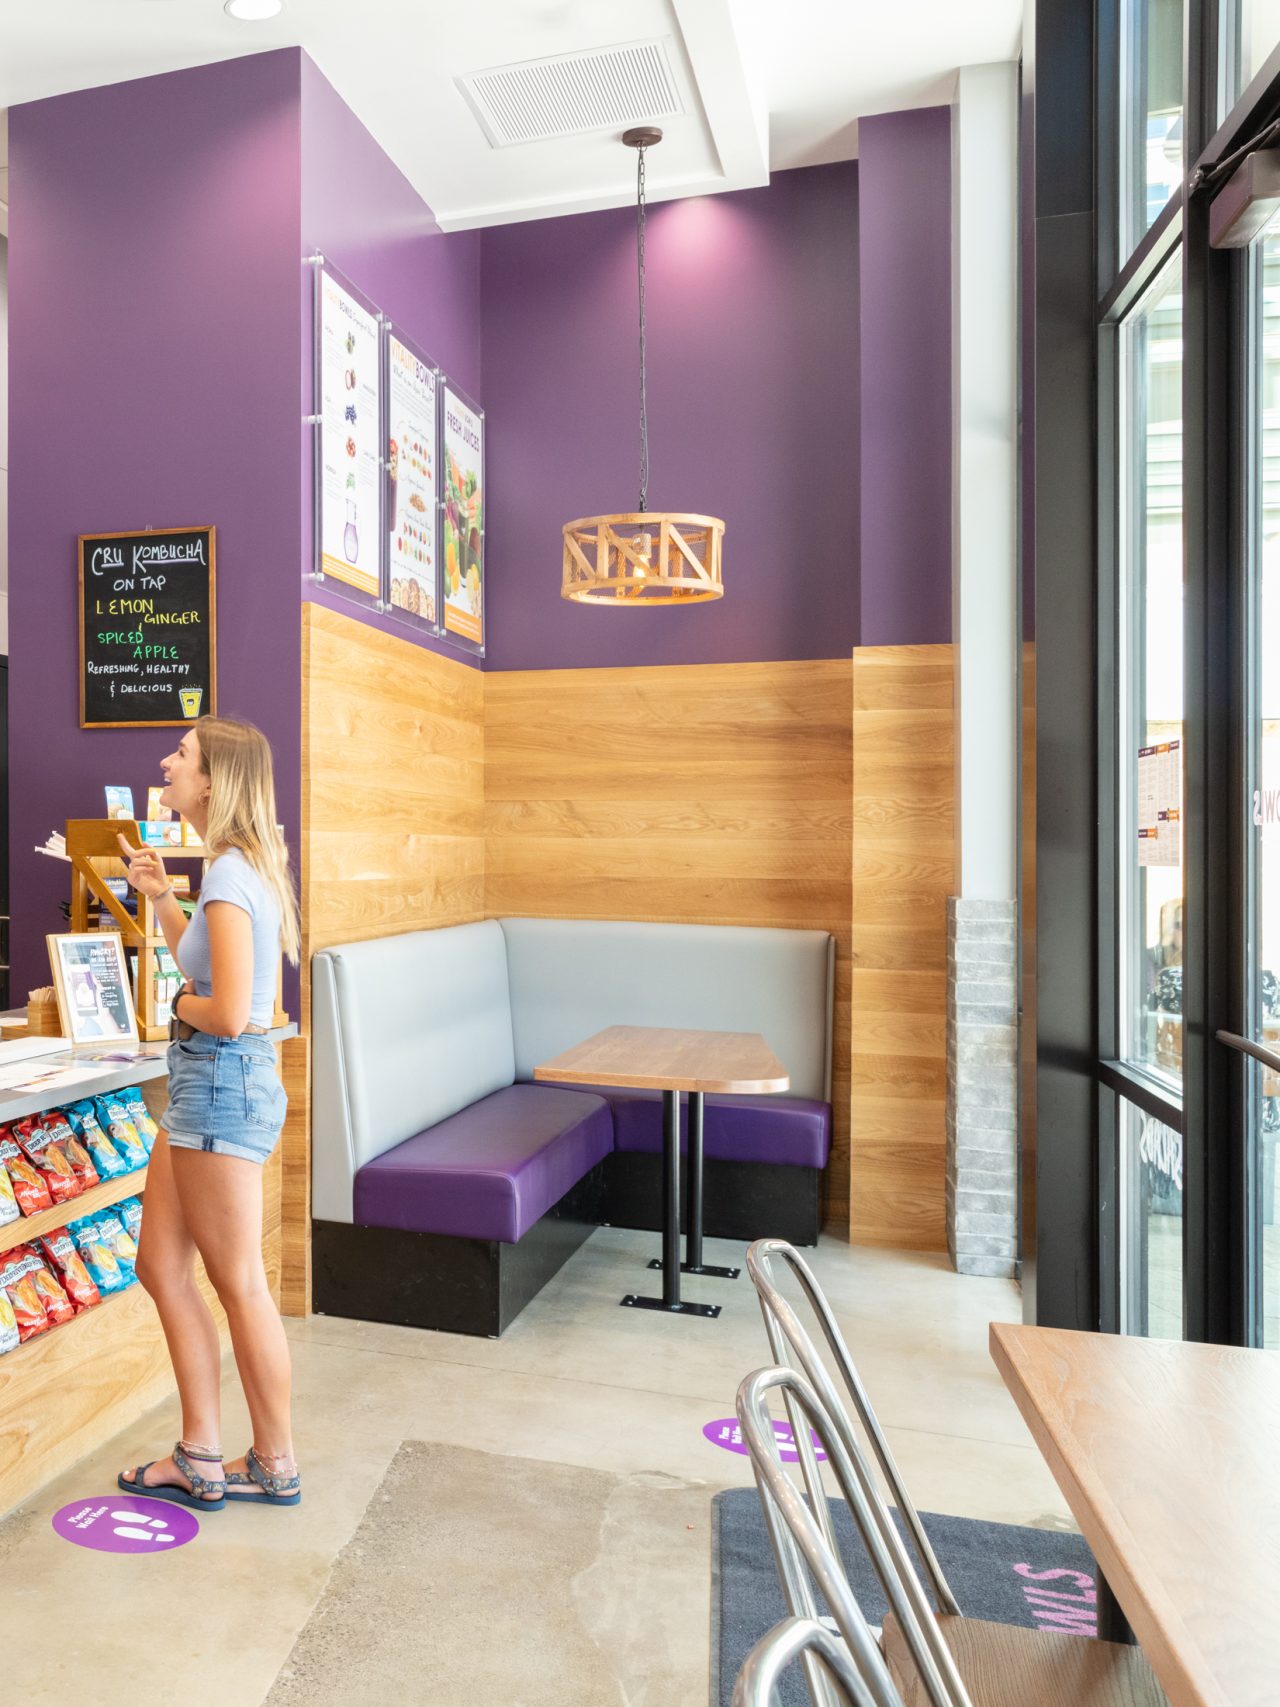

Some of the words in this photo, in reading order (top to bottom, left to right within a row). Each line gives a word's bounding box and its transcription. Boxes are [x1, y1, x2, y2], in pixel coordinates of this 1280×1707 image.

[447, 411, 462, 437] FRESH
[463, 426, 480, 452] JUICES
[92, 547, 124, 575] CRU
[132, 539, 206, 574] KOMBUCHA
[113, 579, 134, 591] ON
[141, 575, 166, 591] TAP
[96, 599, 154, 614] LEMON
[144, 611, 200, 625] GINGER
[97, 632, 144, 644] SPICED
[133, 646, 179, 660] APPLE
[146, 664, 190, 675] HEALTHY
[121, 683, 173, 693] DELICIOUS
[67, 1507, 92, 1523] Please
[75, 1517, 96, 1528] Wait
[89, 1506, 109, 1518] Here
